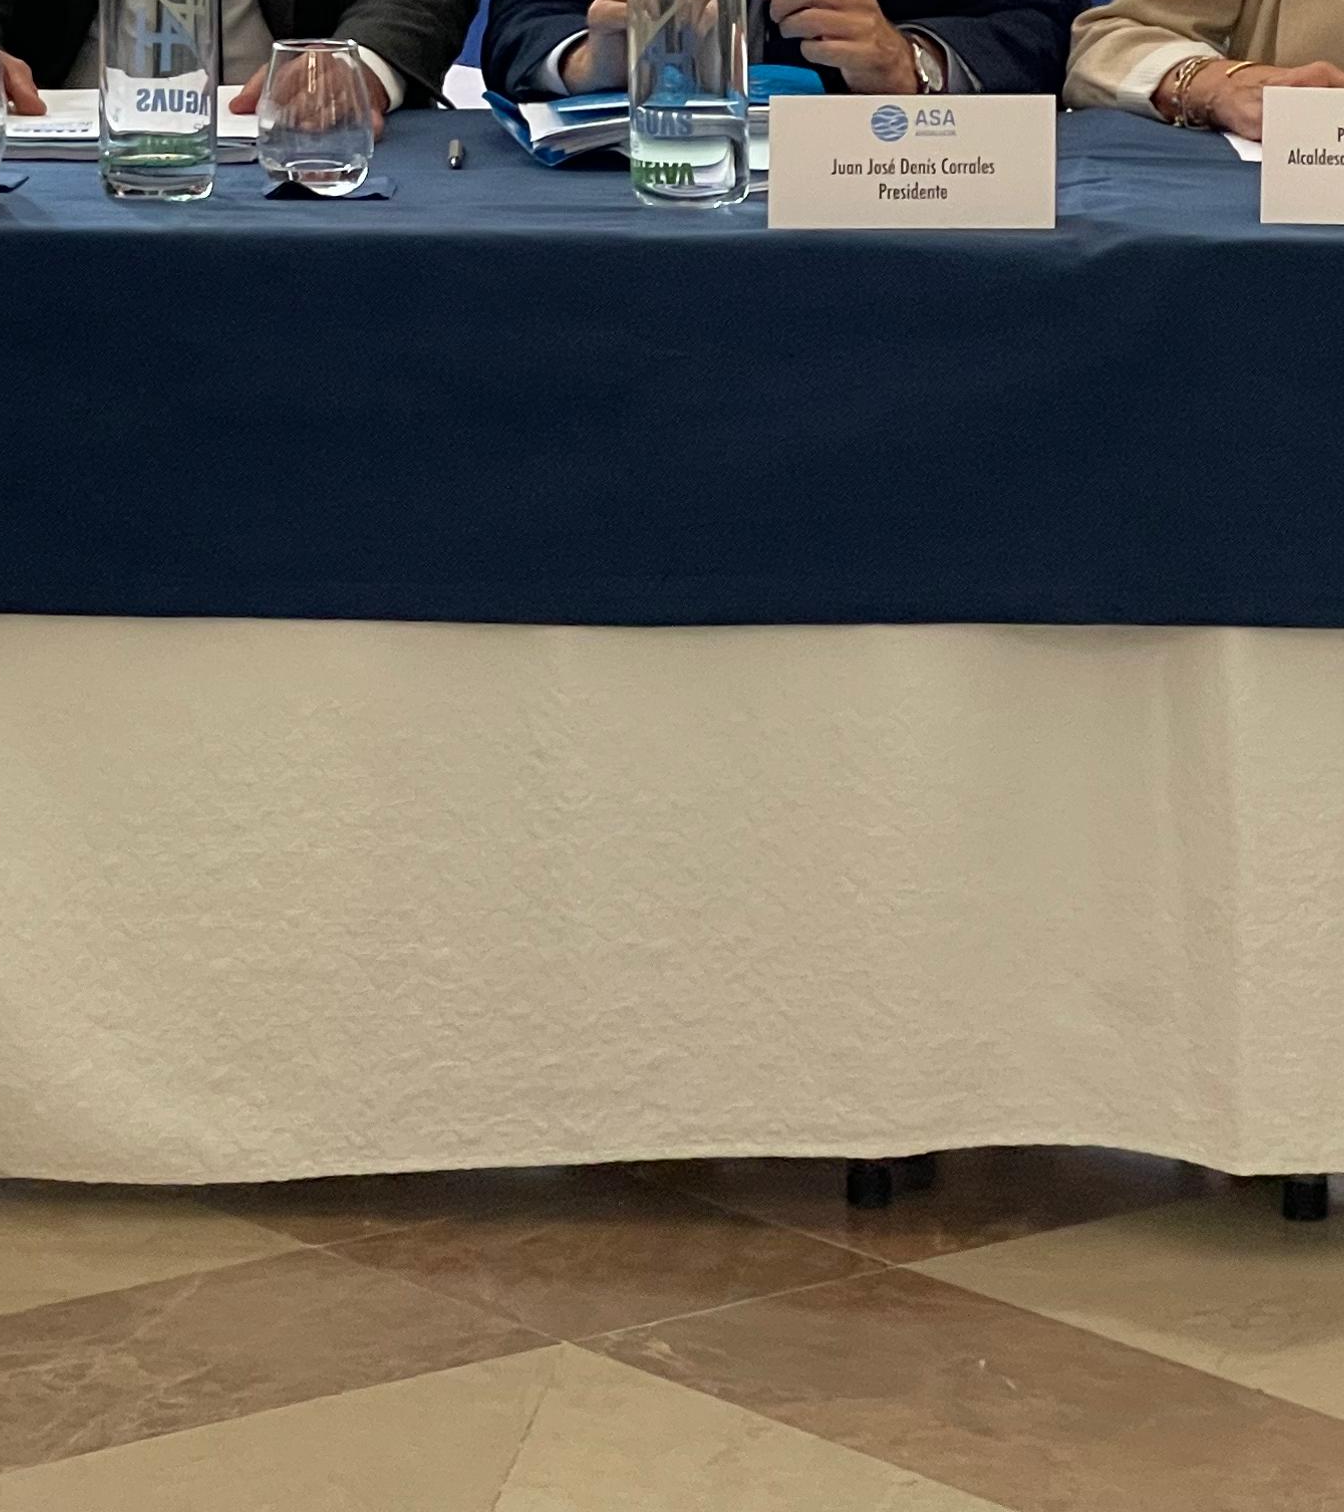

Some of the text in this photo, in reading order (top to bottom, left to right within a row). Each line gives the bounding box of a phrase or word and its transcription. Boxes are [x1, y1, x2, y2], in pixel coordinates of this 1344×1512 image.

[915, 109, 955, 126] ASA
[831, 158, 862, 176] Juan
[866, 157, 895, 175] José
[942, 158, 996, 175] Corrales
[878, 183, 947, 201] Presidente
